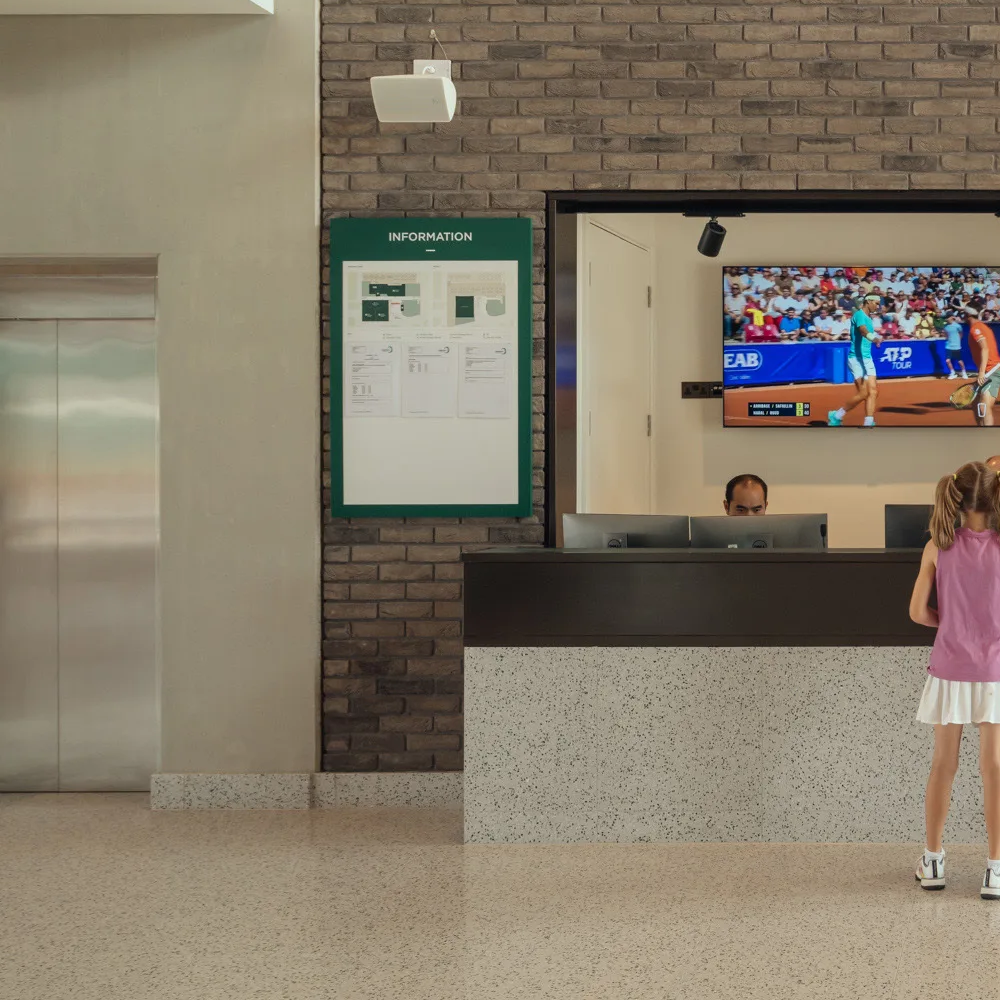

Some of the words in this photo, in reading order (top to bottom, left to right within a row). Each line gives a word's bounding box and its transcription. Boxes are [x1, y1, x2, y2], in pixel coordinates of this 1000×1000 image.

[388, 232, 473, 242] INFORMATION
[724, 353, 759, 368] EAB
[879, 347, 912, 362] ATP
[892, 361, 912, 370] TOUR
